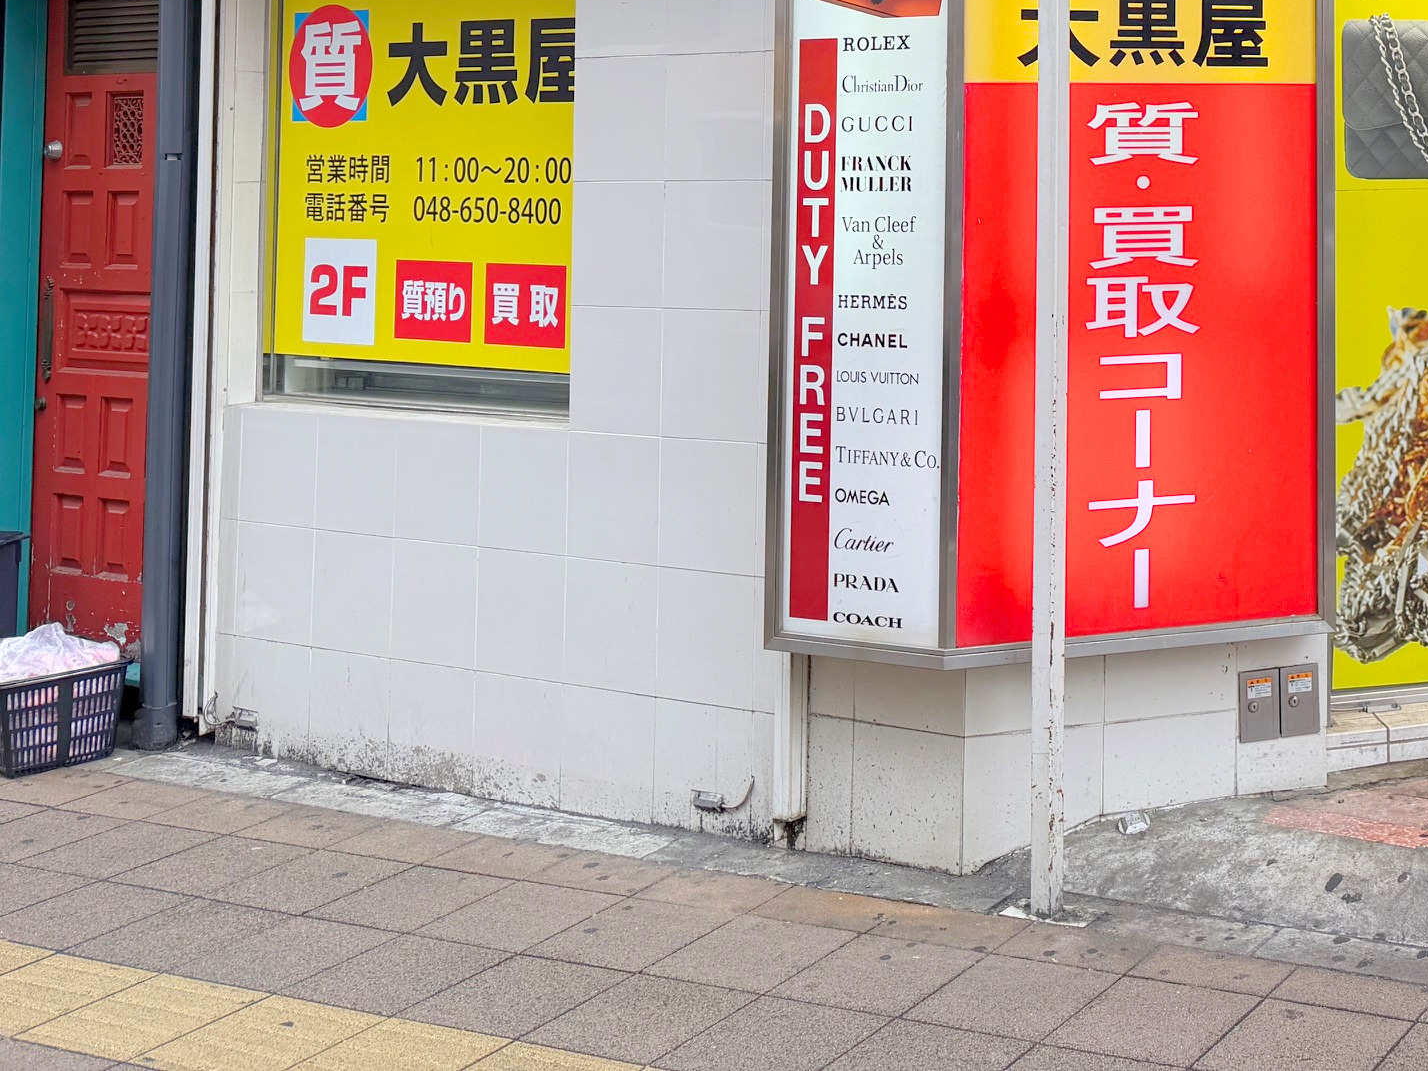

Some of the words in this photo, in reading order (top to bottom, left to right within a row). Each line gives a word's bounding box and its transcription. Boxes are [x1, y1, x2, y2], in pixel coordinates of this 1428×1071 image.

[842, 35, 911, 52] ROLEX
[299, 21, 361, 112] 質
[387, 18, 576, 107] 大黒屋
[841, 115, 913, 133] GUCCI
[306, 155, 391, 185] 営業時間
[840, 154, 912, 173] FRANCK
[839, 177, 912, 194] MULLER
[304, 193, 390, 223] 電話番号
[413, 197, 562, 225] 048-650-8400
[842, 216, 870, 233] Van
[874, 216, 917, 233] Cleef
[872, 236, 884, 250] &
[853, 248, 904, 269] Arpels
[309, 263, 368, 317] 2F
[401, 279, 466, 322] 質預り
[491, 283, 559, 327] 買取
[837, 332, 908, 349] CHANEL
[836, 370, 867, 384] LOUIS
[871, 372, 919, 385] VUITTON
[836, 406, 919, 426] BVLGARI
[834, 488, 890, 506] OMEGA
[834, 528, 894, 554] Cartier
[834, 573, 899, 593] PRADA
[833, 611, 903, 629] COACH
